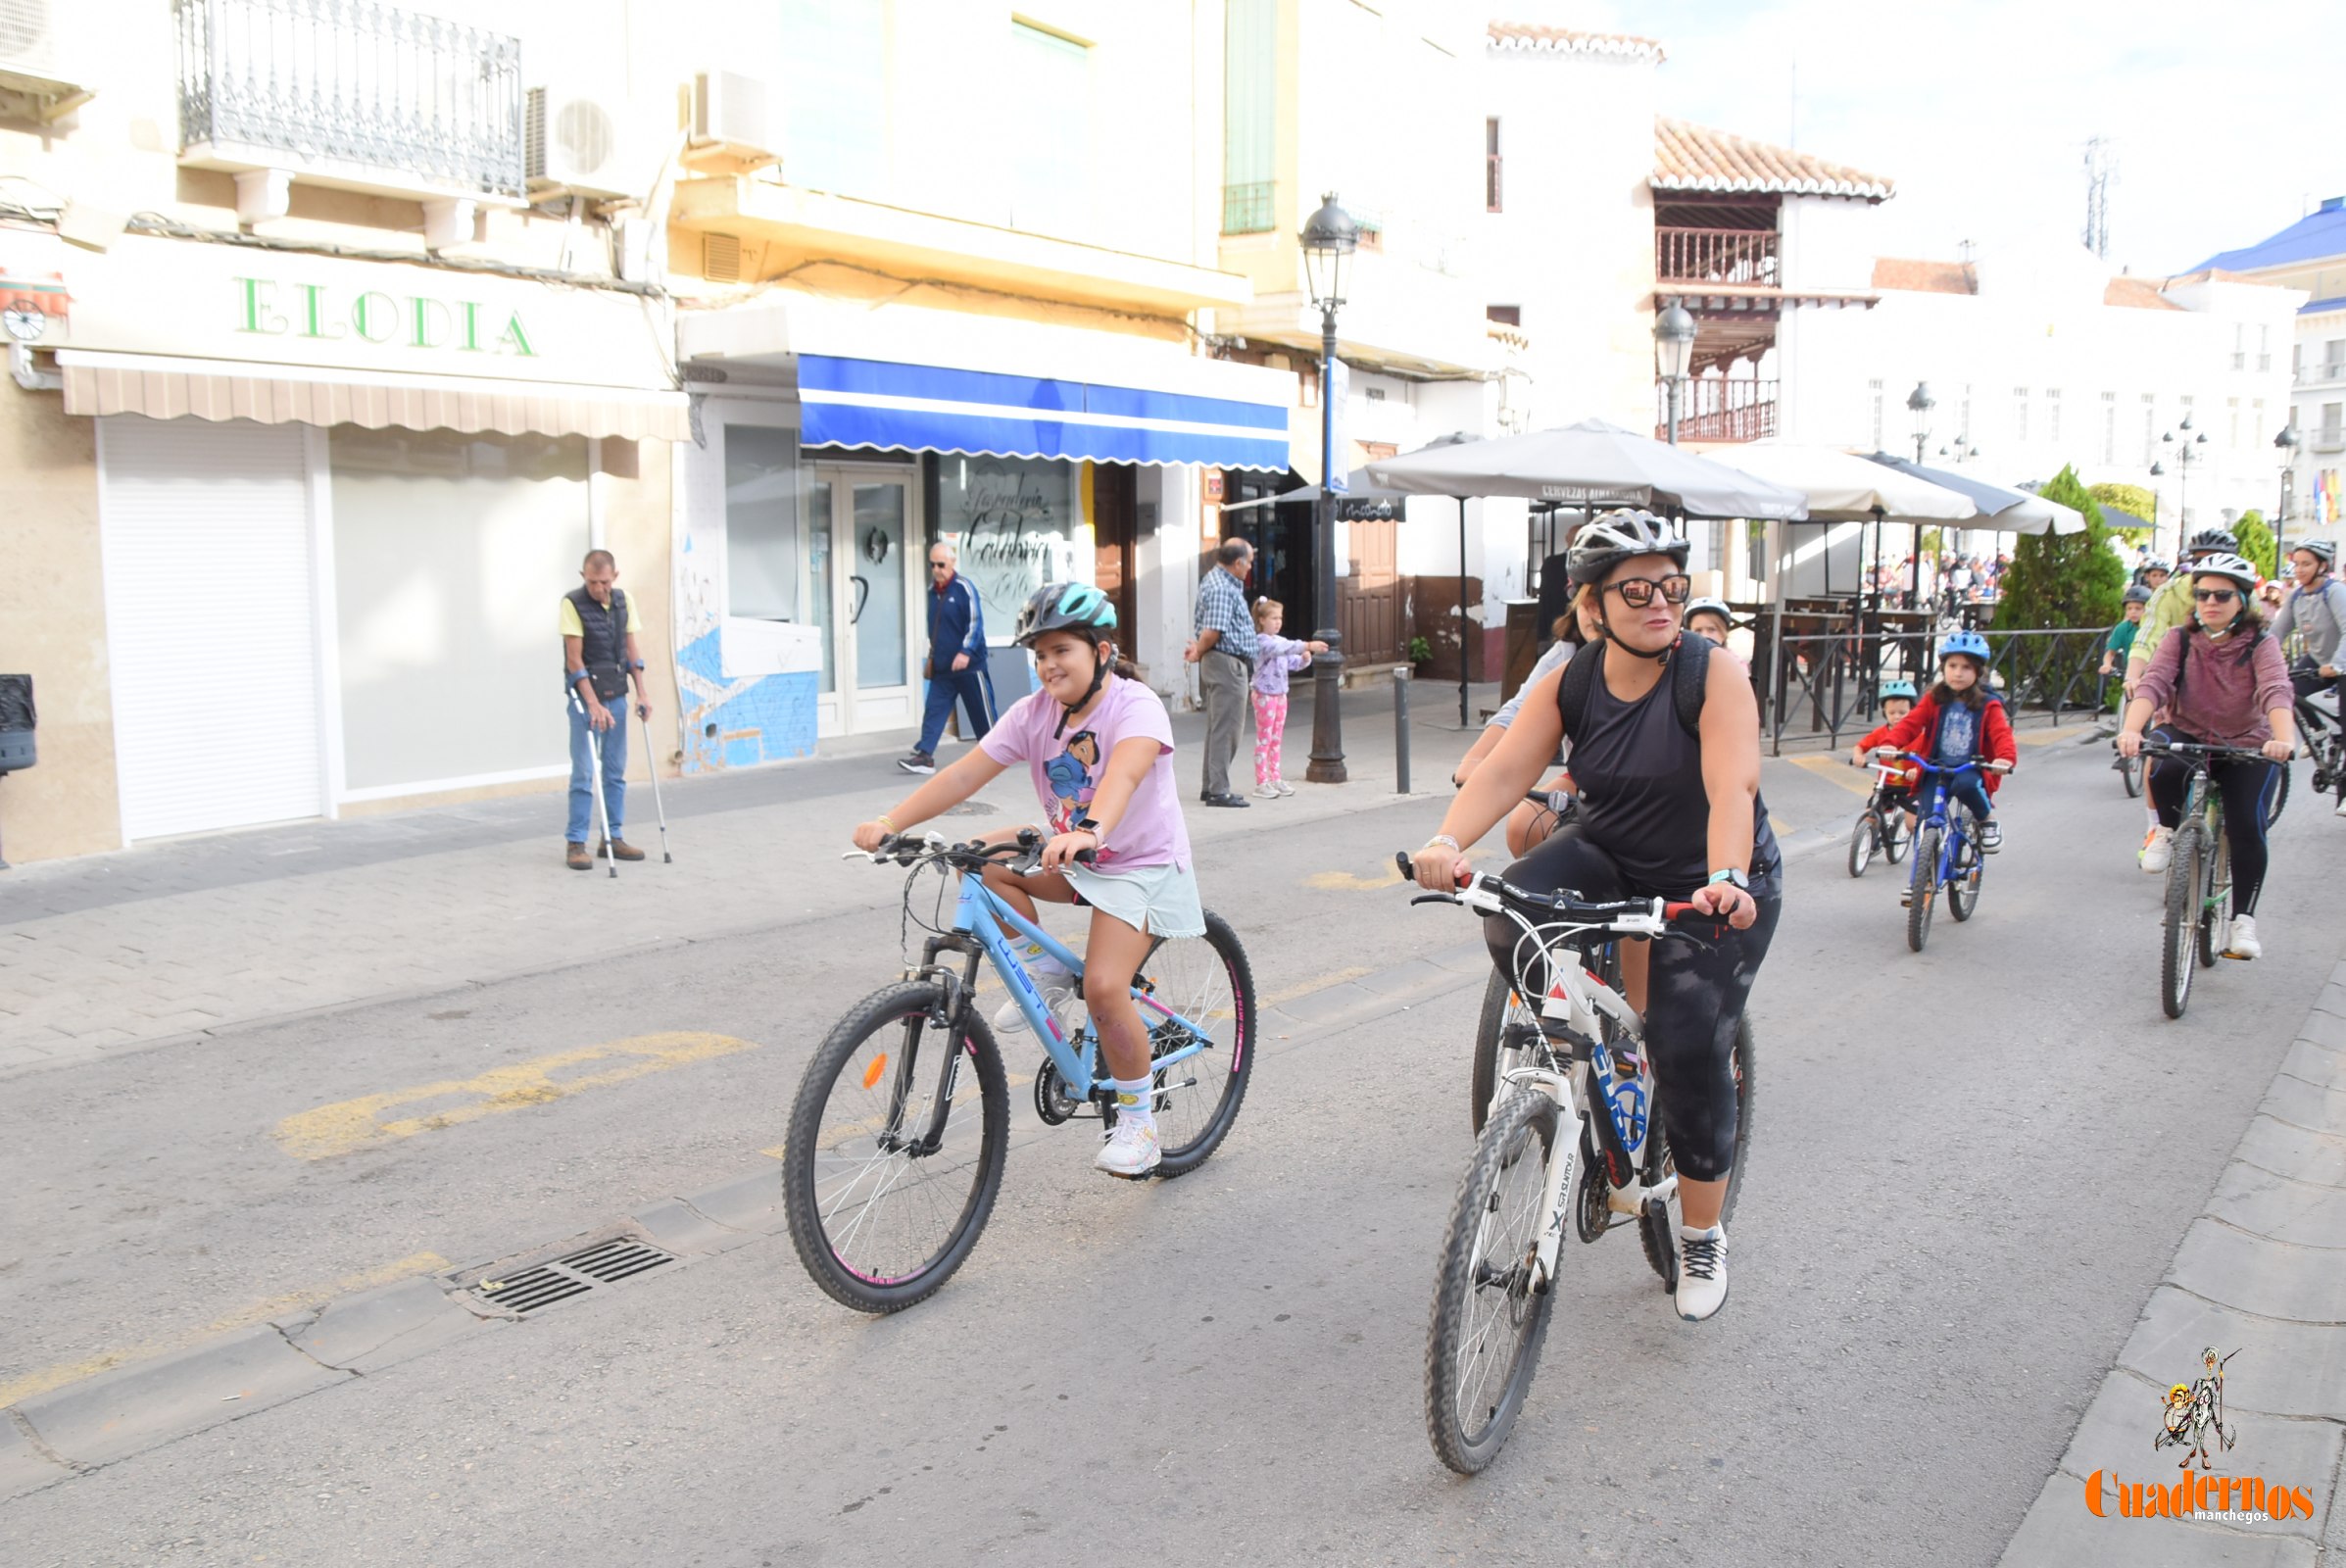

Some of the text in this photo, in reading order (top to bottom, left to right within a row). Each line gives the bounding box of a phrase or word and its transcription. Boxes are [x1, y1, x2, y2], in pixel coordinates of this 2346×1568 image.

[231, 276, 540, 358] ELODIA
[1541, 484, 1587, 500] CERVEZAS
[1561, 1152, 1574, 1193] SUNTOUR
